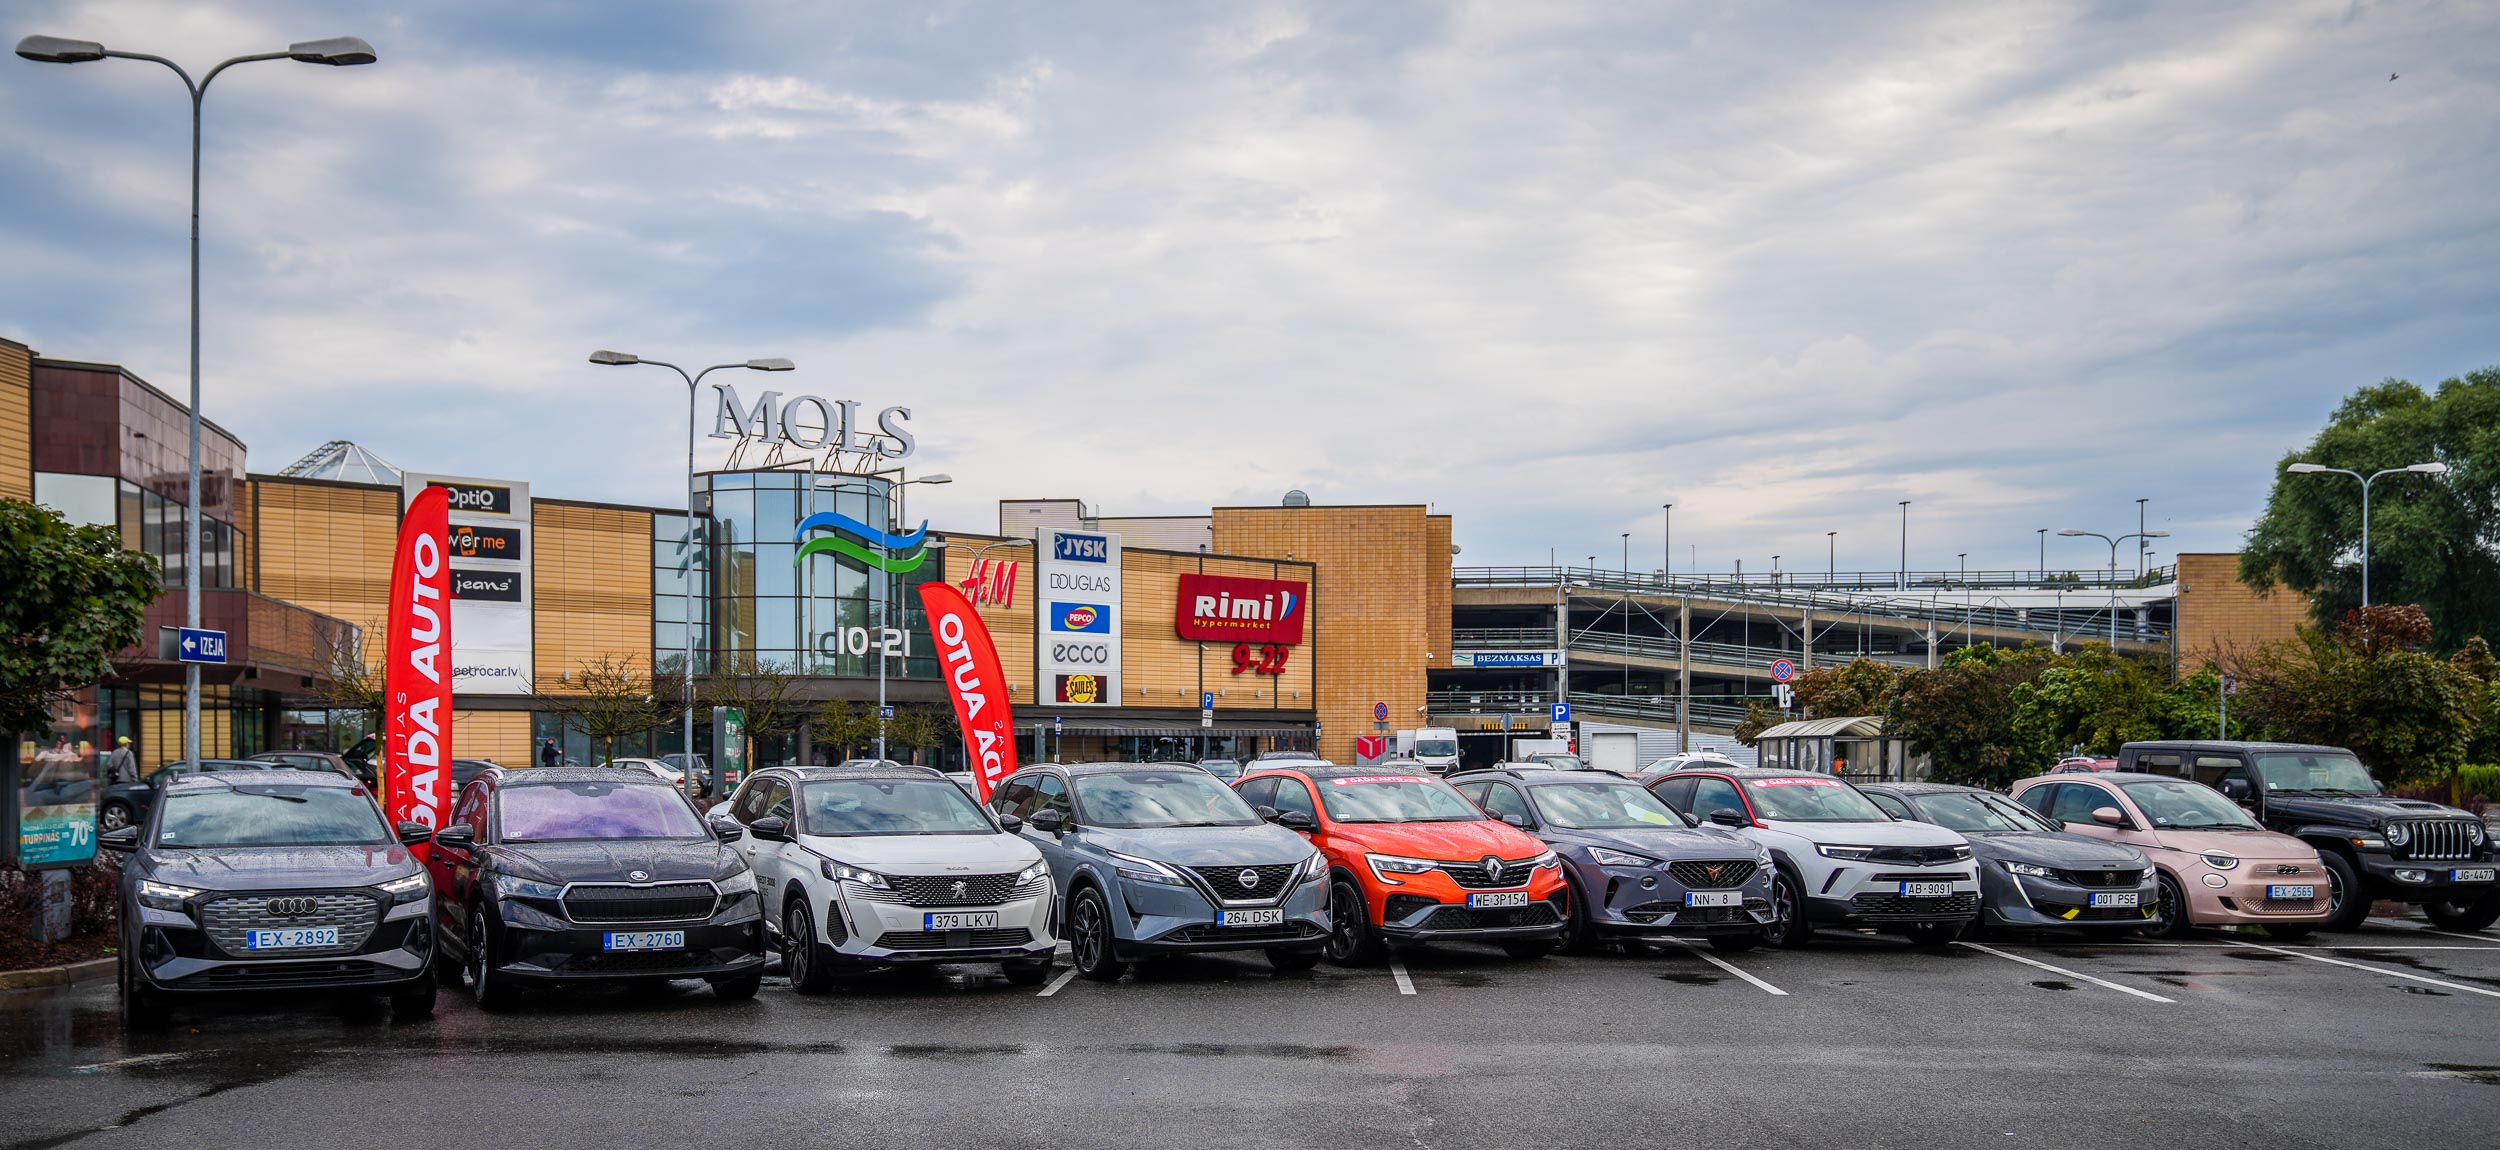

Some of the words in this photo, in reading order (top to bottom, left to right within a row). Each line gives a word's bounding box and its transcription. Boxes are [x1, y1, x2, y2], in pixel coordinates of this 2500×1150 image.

[708, 384, 915, 458] MOLS
[448, 488, 494, 508] OptiO
[449, 534, 481, 549] ver
[483, 536, 505, 549] me
[1063, 538, 1106, 558] JYSK
[455, 573, 509, 594] jeans
[960, 559, 1018, 609] H&M
[1050, 573, 1111, 592] DOUGLAS
[411, 533, 440, 684] AUTO
[1194, 591, 1274, 621] Rimi
[1068, 613, 1093, 622] PEPCO
[1193, 619, 1271, 629] Hypermarket
[200, 636, 224, 657] IZEJA
[838, 626, 911, 656] 10-21
[1053, 644, 1108, 664] ecco
[1231, 643, 1290, 675] 9-22
[1477, 654, 1542, 662] BEZMAKSAS
[453, 666, 518, 677] ectrocar.lv
[1069, 680, 1094, 697] SAULES
[1205, 694, 1212, 707] P
[1555, 706, 1566, 720] P
[395, 692, 407, 821] ATVIJAS
[2457, 870, 2493, 880] JG-4477
[1908, 883, 1950, 894] AB-9091
[2274, 887, 2312, 897] EX-2565
[1493, 893, 1526, 906] 3P154
[2097, 894, 2112, 905] 001
[2117, 894, 2136, 905] PSE
[935, 915, 959, 928] 379
[965, 914, 994, 927] LKV
[1226, 911, 1248, 924] 264
[1253, 910, 1280, 923] DSK
[260, 930, 335, 947] EX-2892
[615, 932, 682, 948] EX-2760
